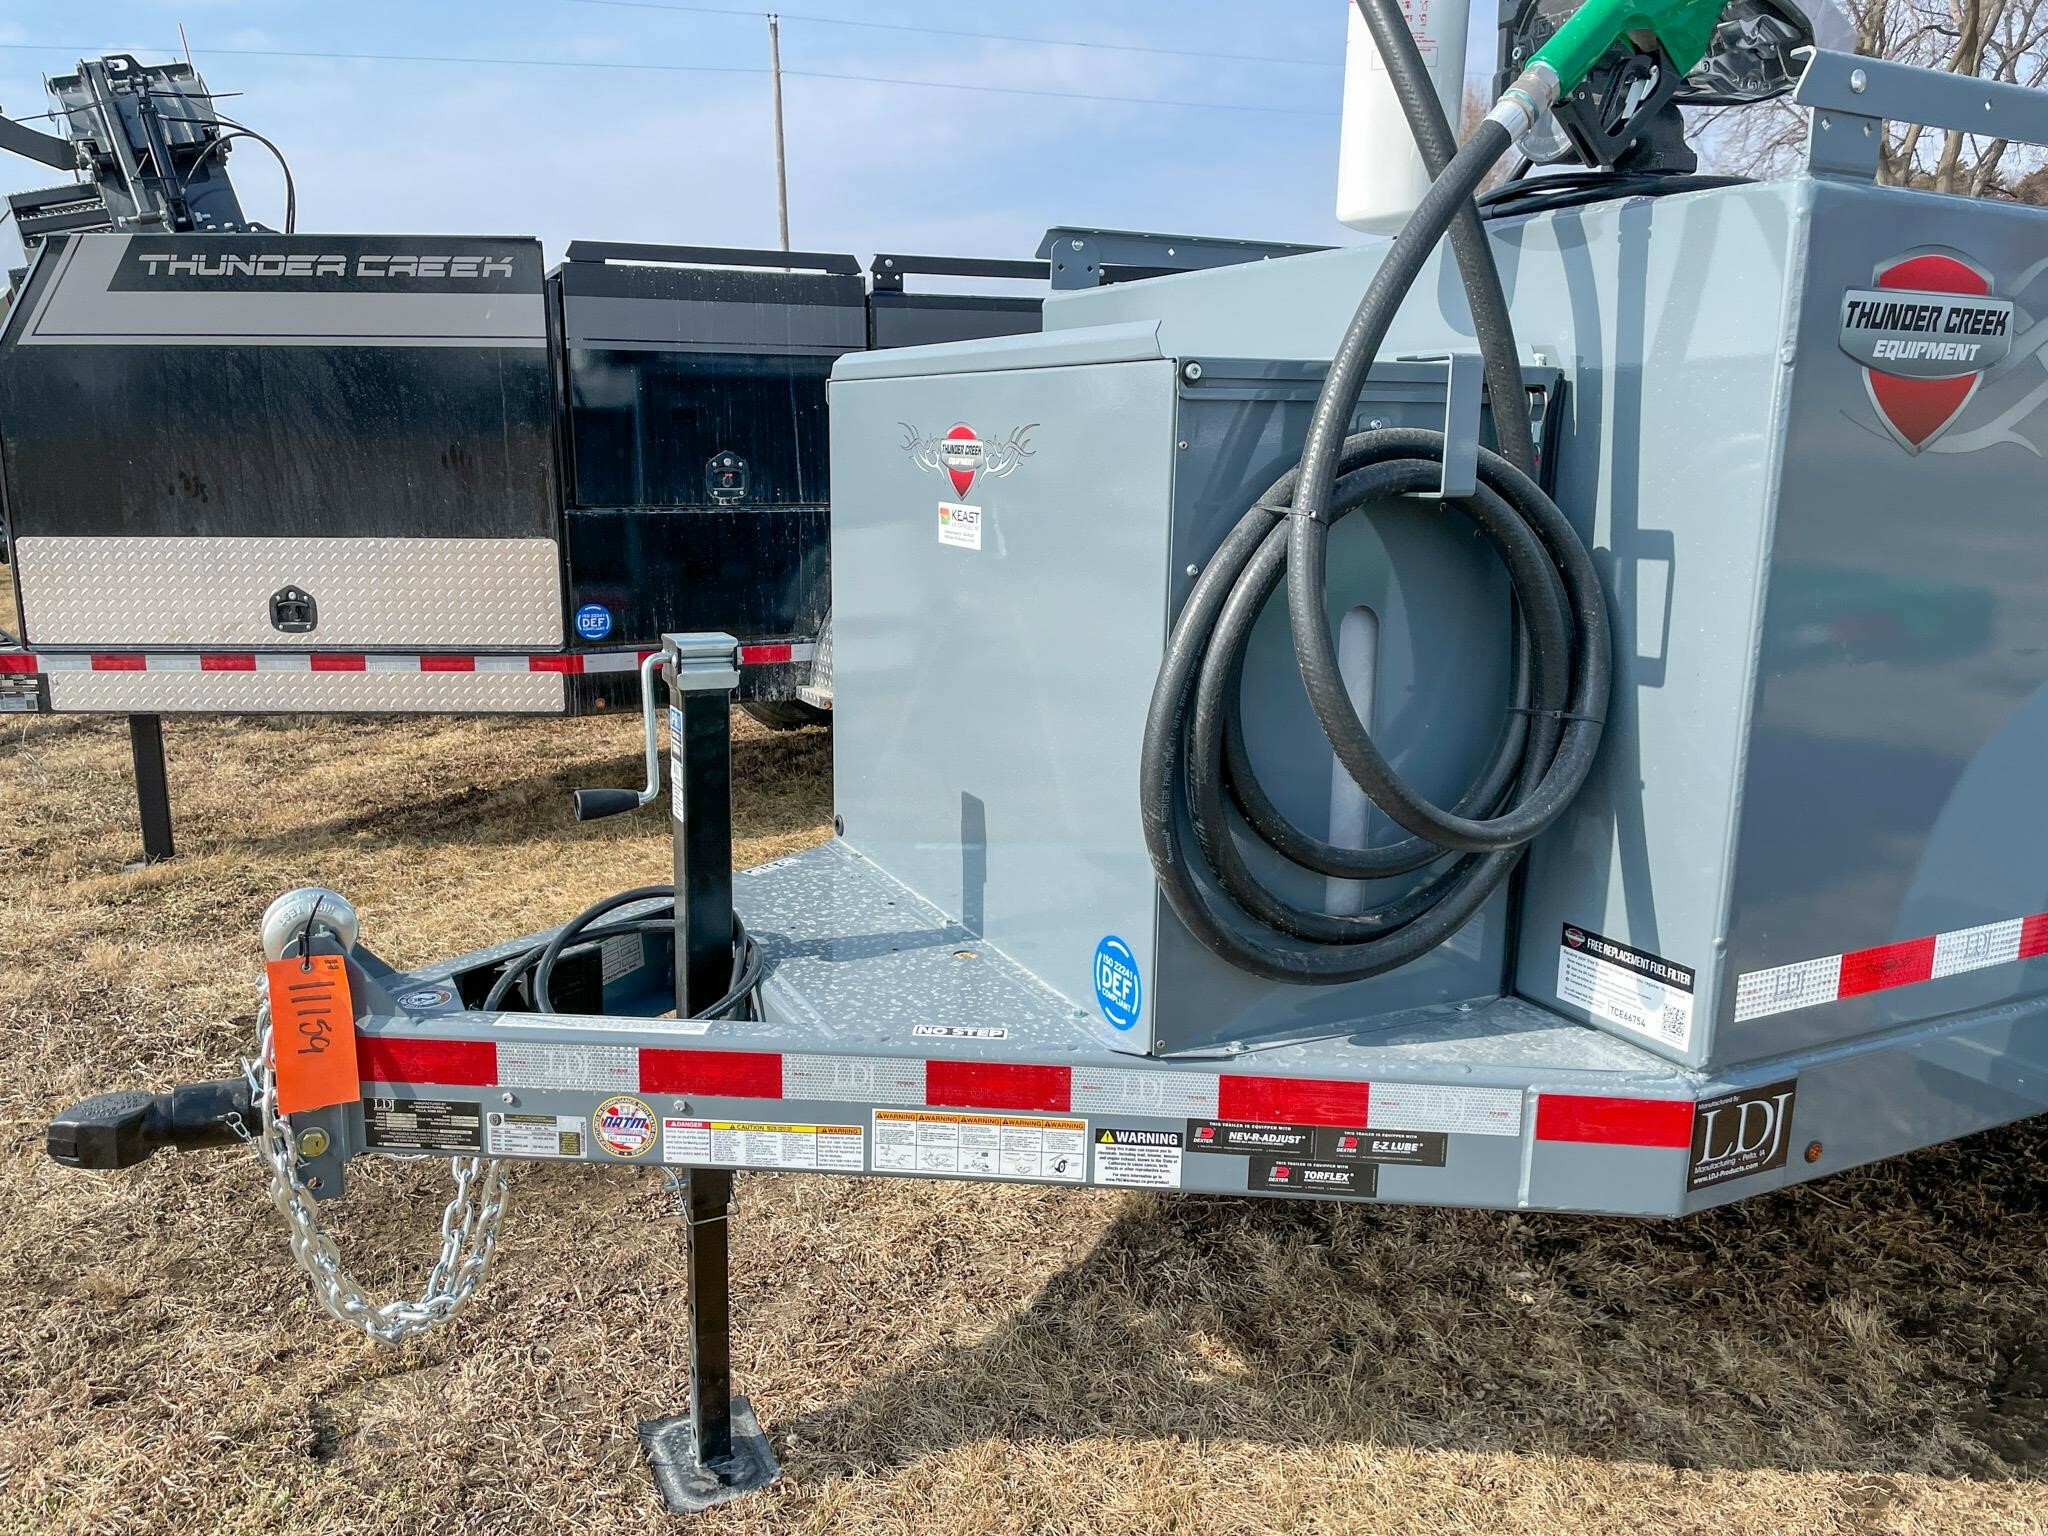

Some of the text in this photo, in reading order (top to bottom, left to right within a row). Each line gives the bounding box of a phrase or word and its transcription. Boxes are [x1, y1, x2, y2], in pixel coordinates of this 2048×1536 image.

[138, 254, 514, 278] THUNDER CREEK
[1845, 300, 2010, 337] THUNDER CREEK
[1872, 339, 1982, 362] EQUIPMENT
[942, 444, 983, 456] THUNDER CREEK
[952, 509, 980, 524] KEAST
[582, 617, 605, 627] DEF
[1102, 953, 1133, 980] ISO 22241
[1587, 938, 1603, 953] FREE
[1603, 943, 1650, 970] REPLACEMENT
[1650, 960, 1667, 977] FUEL
[1667, 967, 1691, 986] FILTER
[1102, 963, 1133, 1001] DEF
[1102, 987, 1132, 1012] COMPLIANT
[288, 981, 336, 1054] 11159
[1610, 1006, 1646, 1027] TCE66754
[917, 1026, 1004, 1037] NO STEP
[374, 1098, 396, 1113] LDJ
[1698, 1097, 1733, 1110] Manufactured
[966, 1117, 1000, 1125] WARNING
[1009, 1118, 1042, 1127] WARNING
[1051, 1121, 1084, 1129] WARNING
[1696, 1092, 1794, 1165] LDJ
[1116, 1131, 1178, 1145] WARNING
[1372, 1141, 1389, 1150] E-Z
[1693, 1162, 1759, 1184] www.LDJ-Products.com
[1694, 1156, 1736, 1174] Manufacturing
